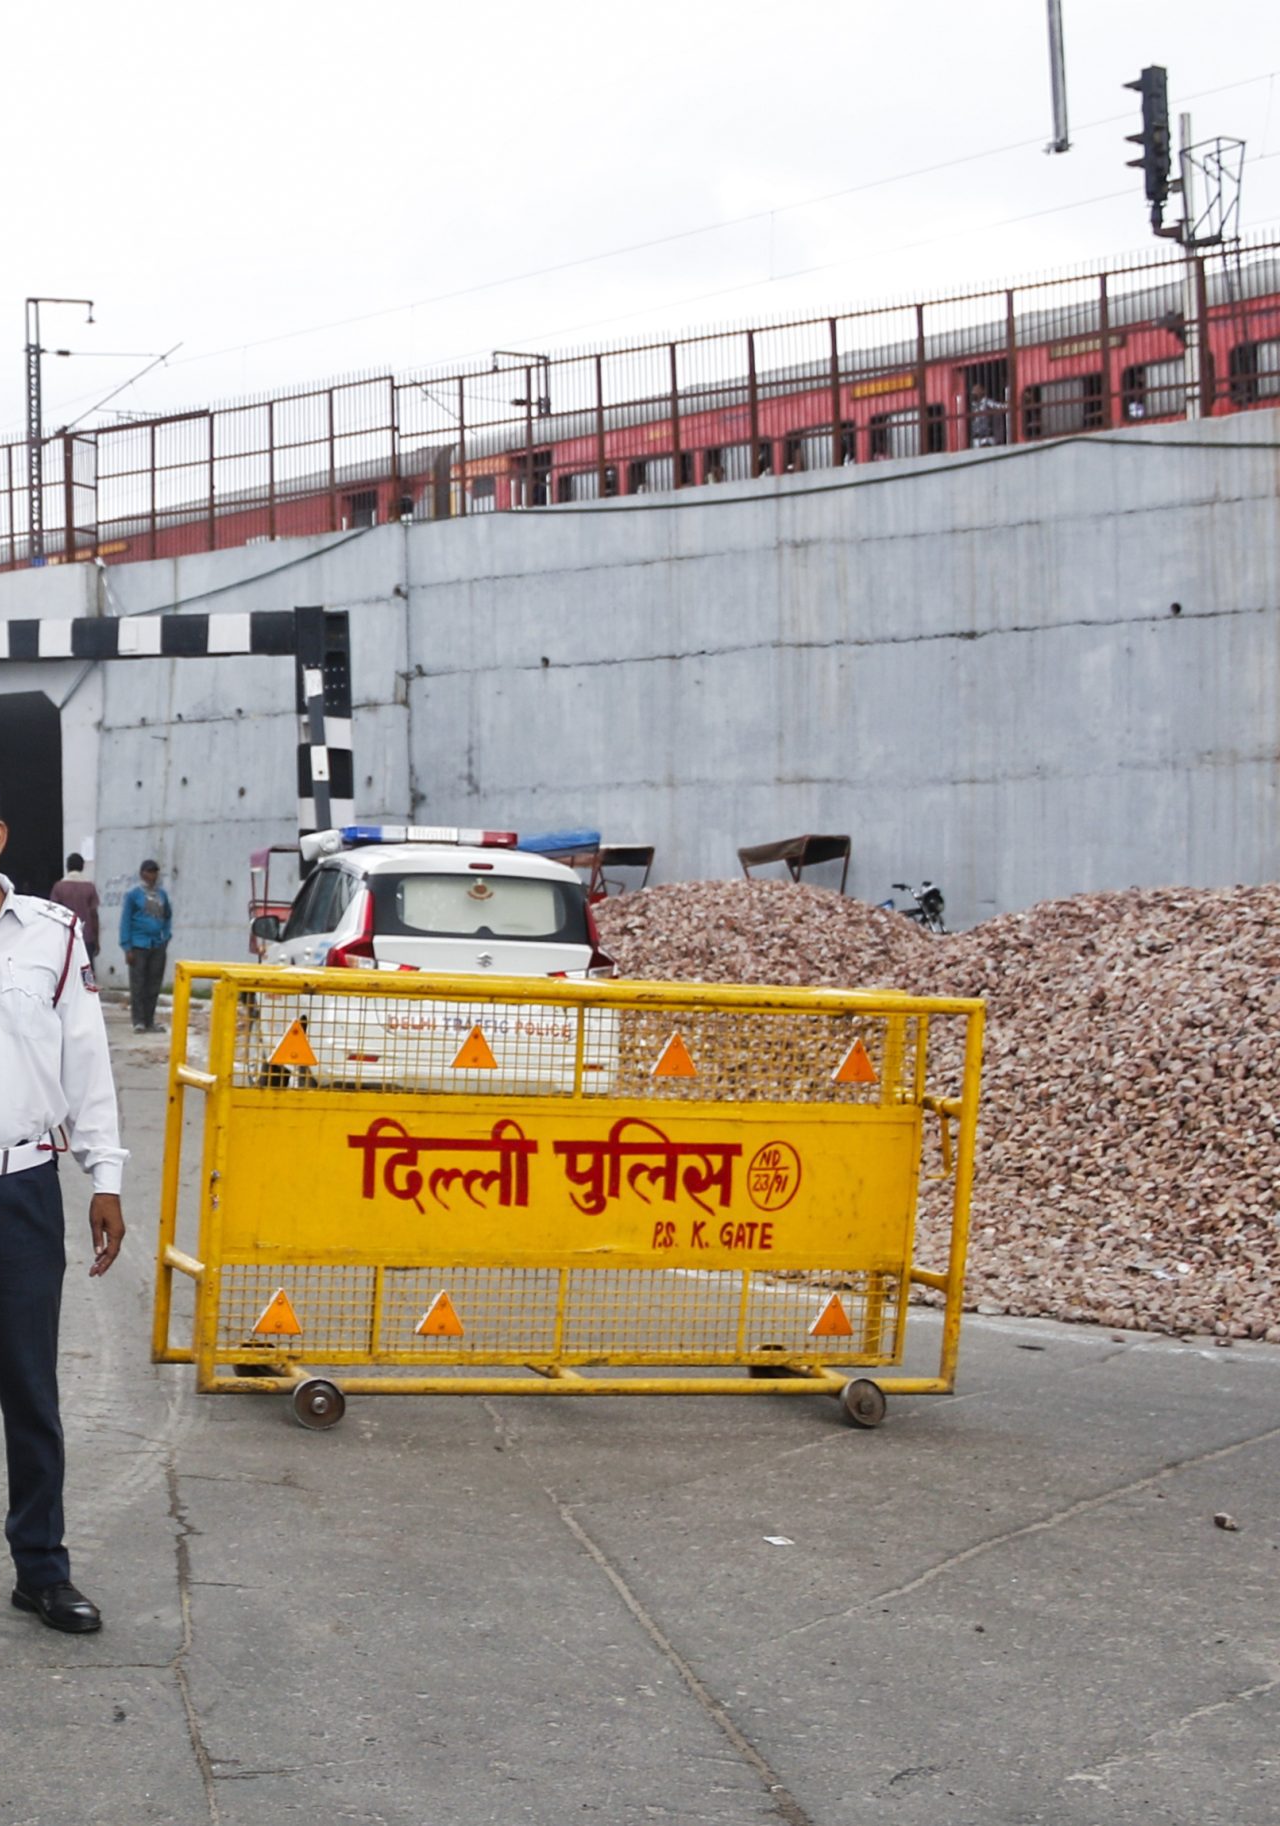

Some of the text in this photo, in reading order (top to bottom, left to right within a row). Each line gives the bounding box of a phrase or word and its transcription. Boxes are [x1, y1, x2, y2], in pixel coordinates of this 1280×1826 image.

[388, 1015, 436, 1030] DELHI
[515, 1020, 571, 1038] POLICE
[347, 1117, 743, 1216] दिल्ली पुलिस
[690, 1220, 709, 1249] K.
[719, 1221, 774, 1250] GATE
